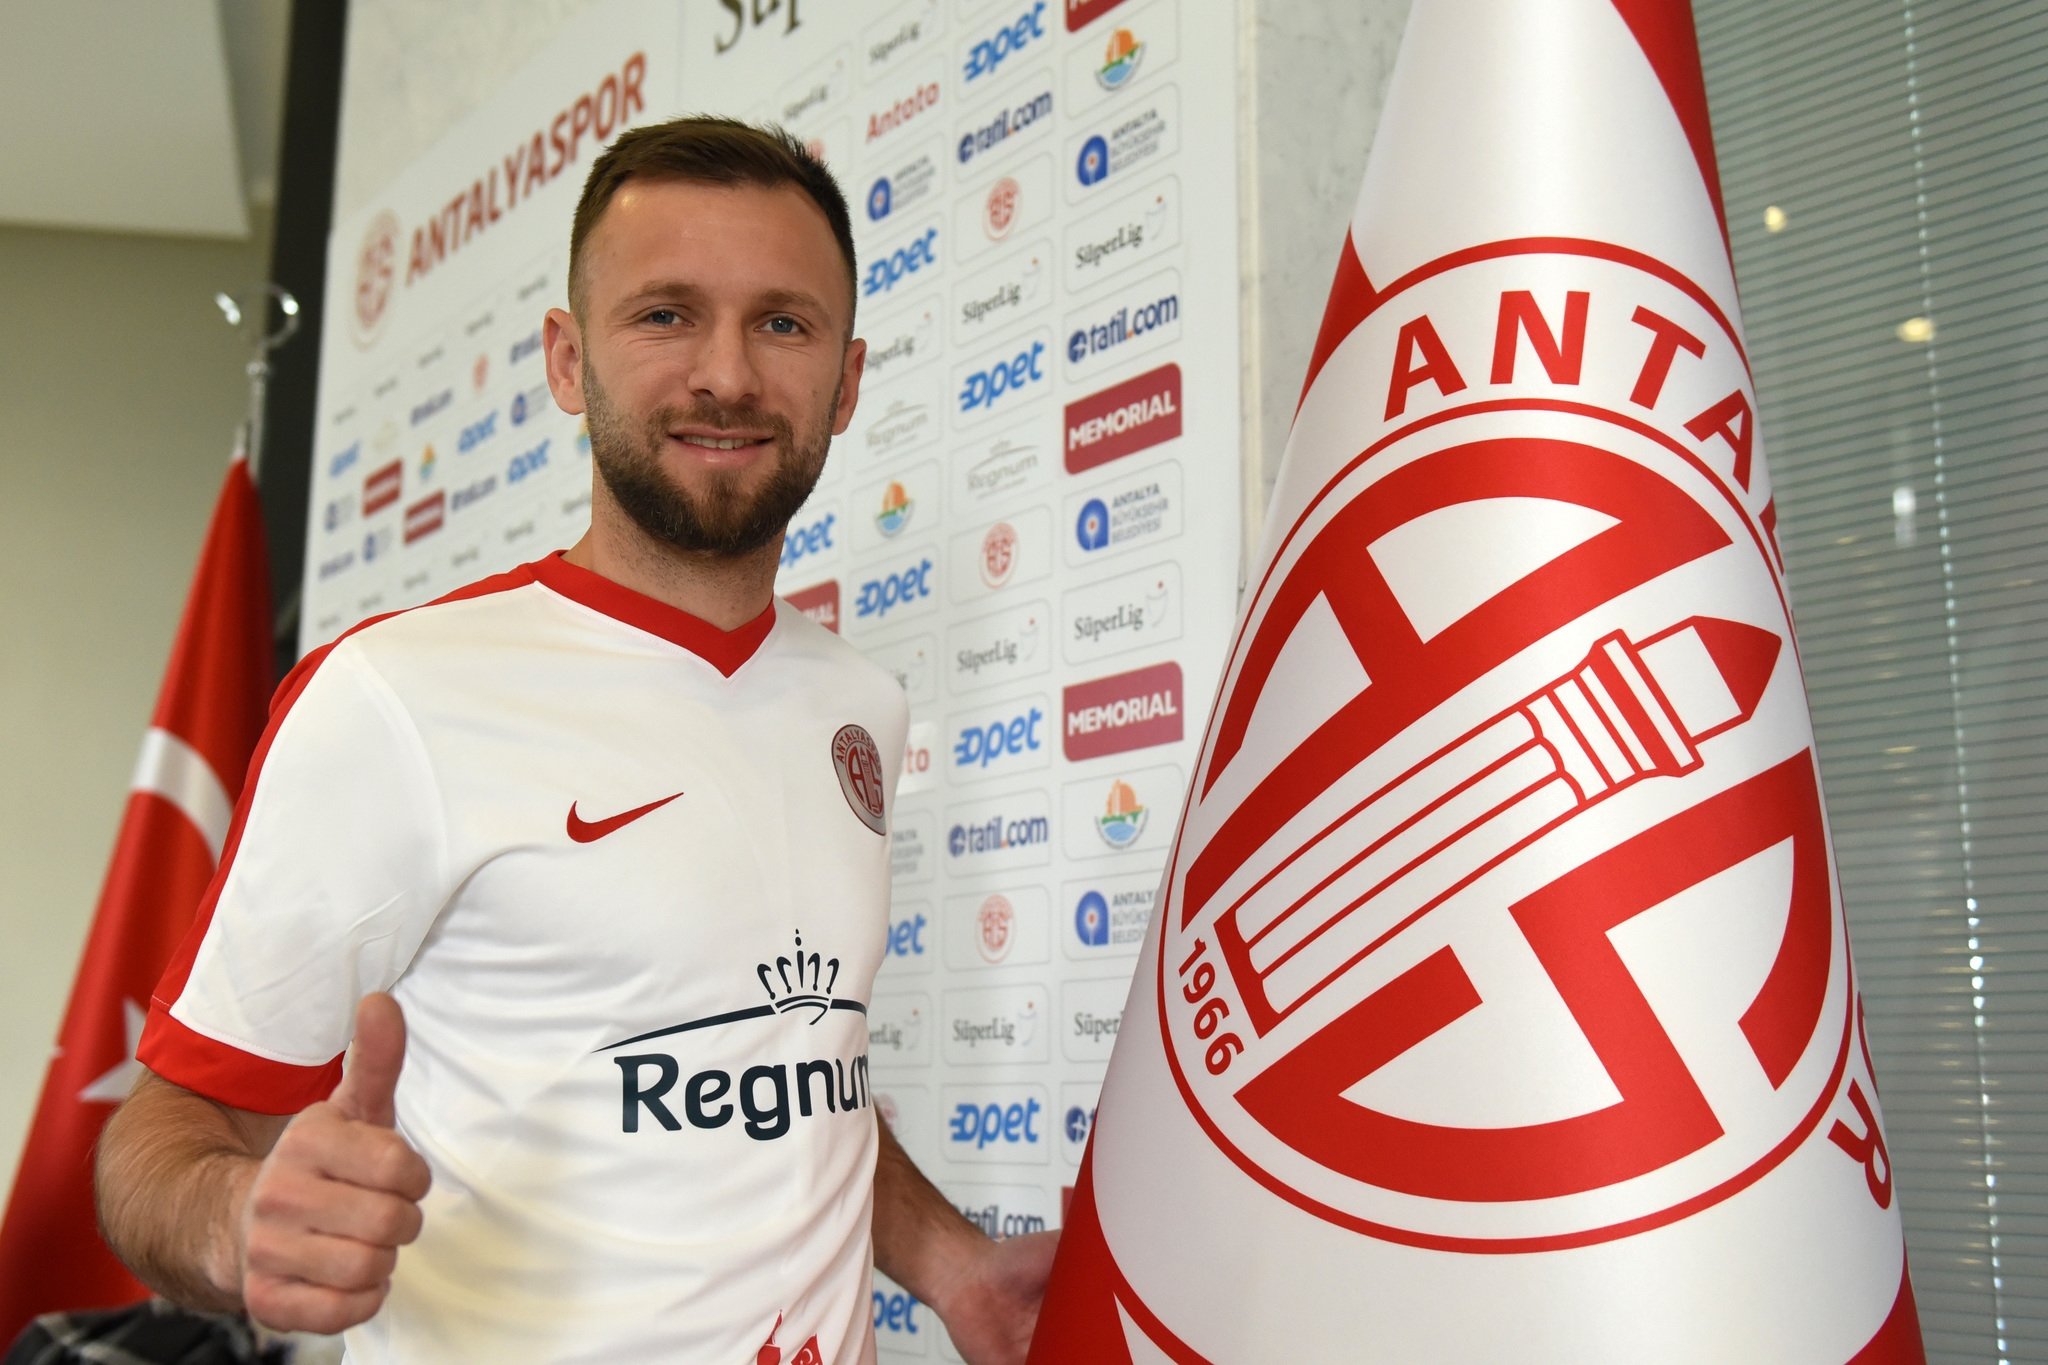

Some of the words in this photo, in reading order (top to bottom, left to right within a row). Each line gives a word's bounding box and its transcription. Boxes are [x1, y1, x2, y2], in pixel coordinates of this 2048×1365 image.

[405, 51, 646, 287] ANTALYASPOR
[1075, 224, 1143, 268] SüperLig
[1068, 391, 1176, 450] MEMORIAL
[1075, 606, 1144, 640] SüperLig
[957, 638, 1018, 675] SüperLig
[1067, 691, 1178, 737] MEMORIAL
[1112, 891, 1153, 906] ANTALY
[1178, 937, 1245, 1076] 1966
[952, 1018, 1016, 1047] SüperLig
[613, 1053, 872, 1141] Regnum
